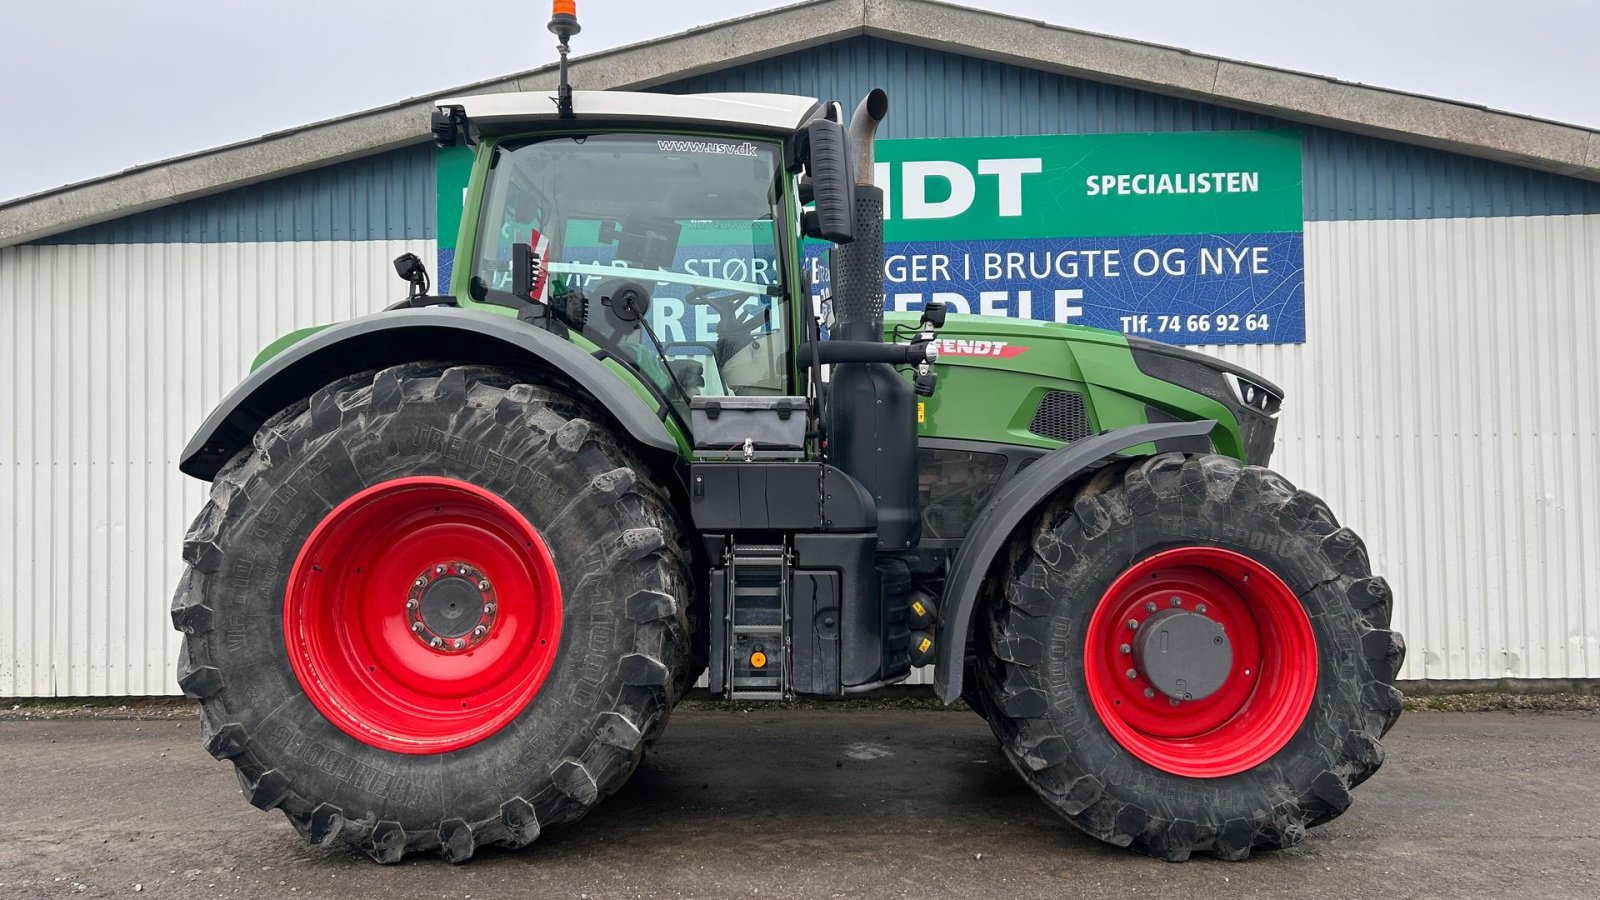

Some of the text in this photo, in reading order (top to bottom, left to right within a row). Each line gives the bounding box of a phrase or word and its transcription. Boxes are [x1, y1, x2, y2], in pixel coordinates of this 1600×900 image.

[657, 140, 757, 156] www.usv.dk
[1086, 172, 1259, 196] SPECIALISTEN
[884, 254, 951, 282] GER
[964, 253, 970, 280] I
[984, 250, 1120, 281] BRUGTE
[1133, 248, 1186, 276] OG
[1200, 247, 1269, 275] NYE
[1120, 314, 1269, 334] Tlf. 74 66 92 64
[935, 339, 1008, 356] FENDT
